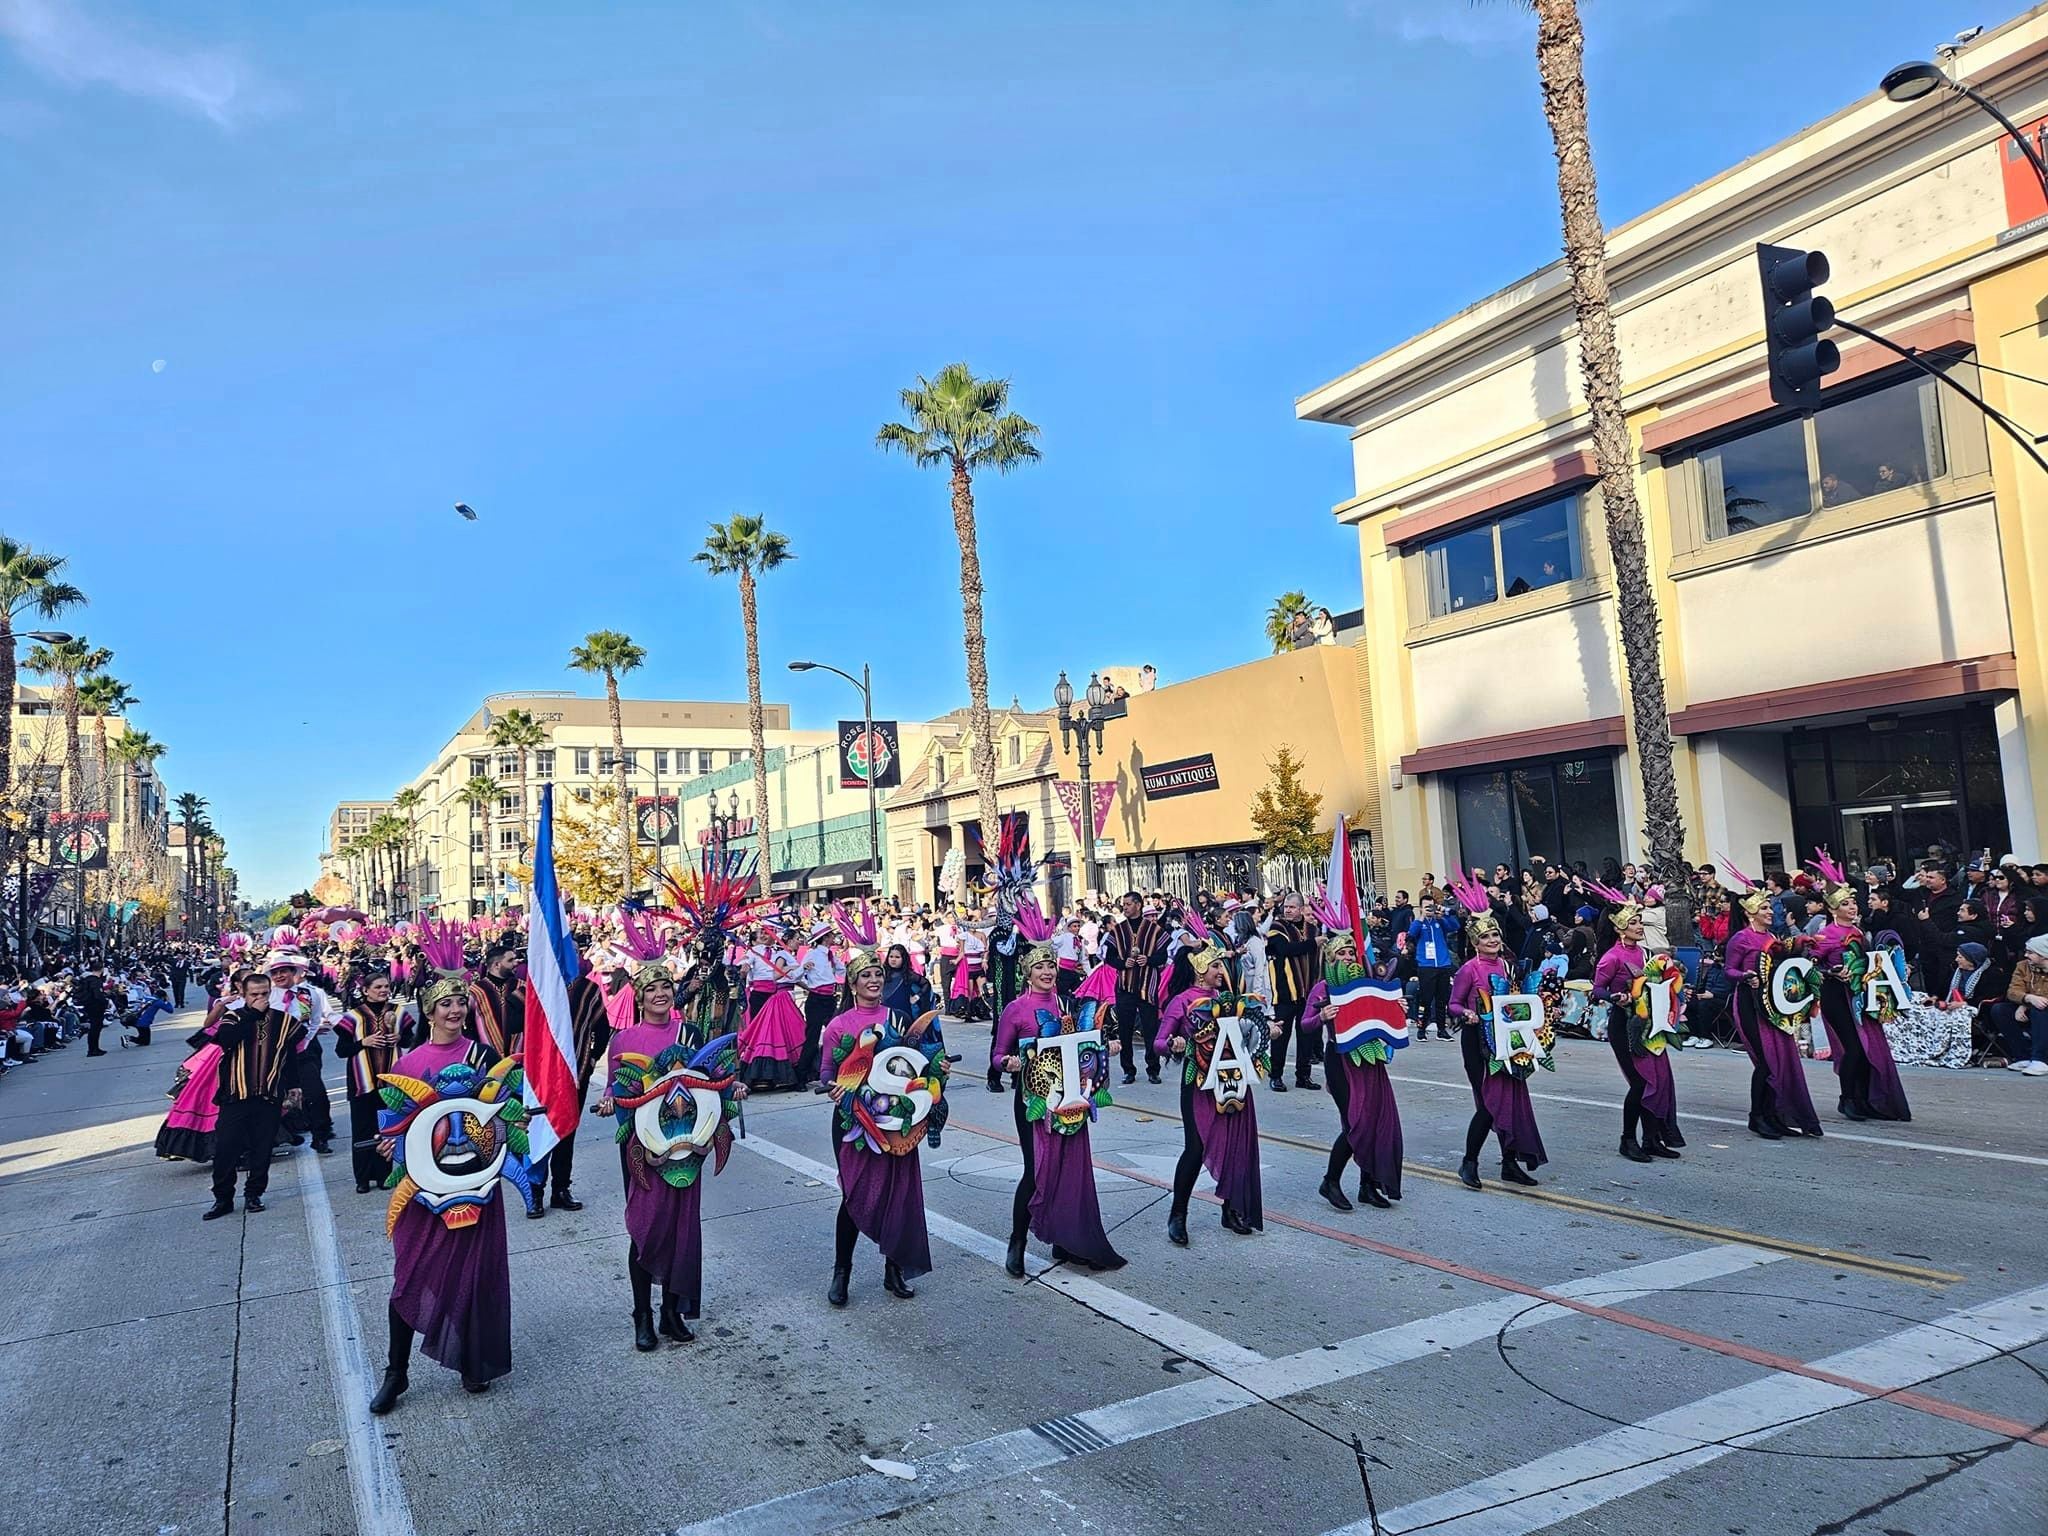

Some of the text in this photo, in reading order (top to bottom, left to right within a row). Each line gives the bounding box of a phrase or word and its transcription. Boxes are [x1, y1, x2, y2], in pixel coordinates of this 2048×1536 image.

[840, 725, 863, 748] ROSE
[1144, 766, 1216, 790] RUMI ANTIQUES
